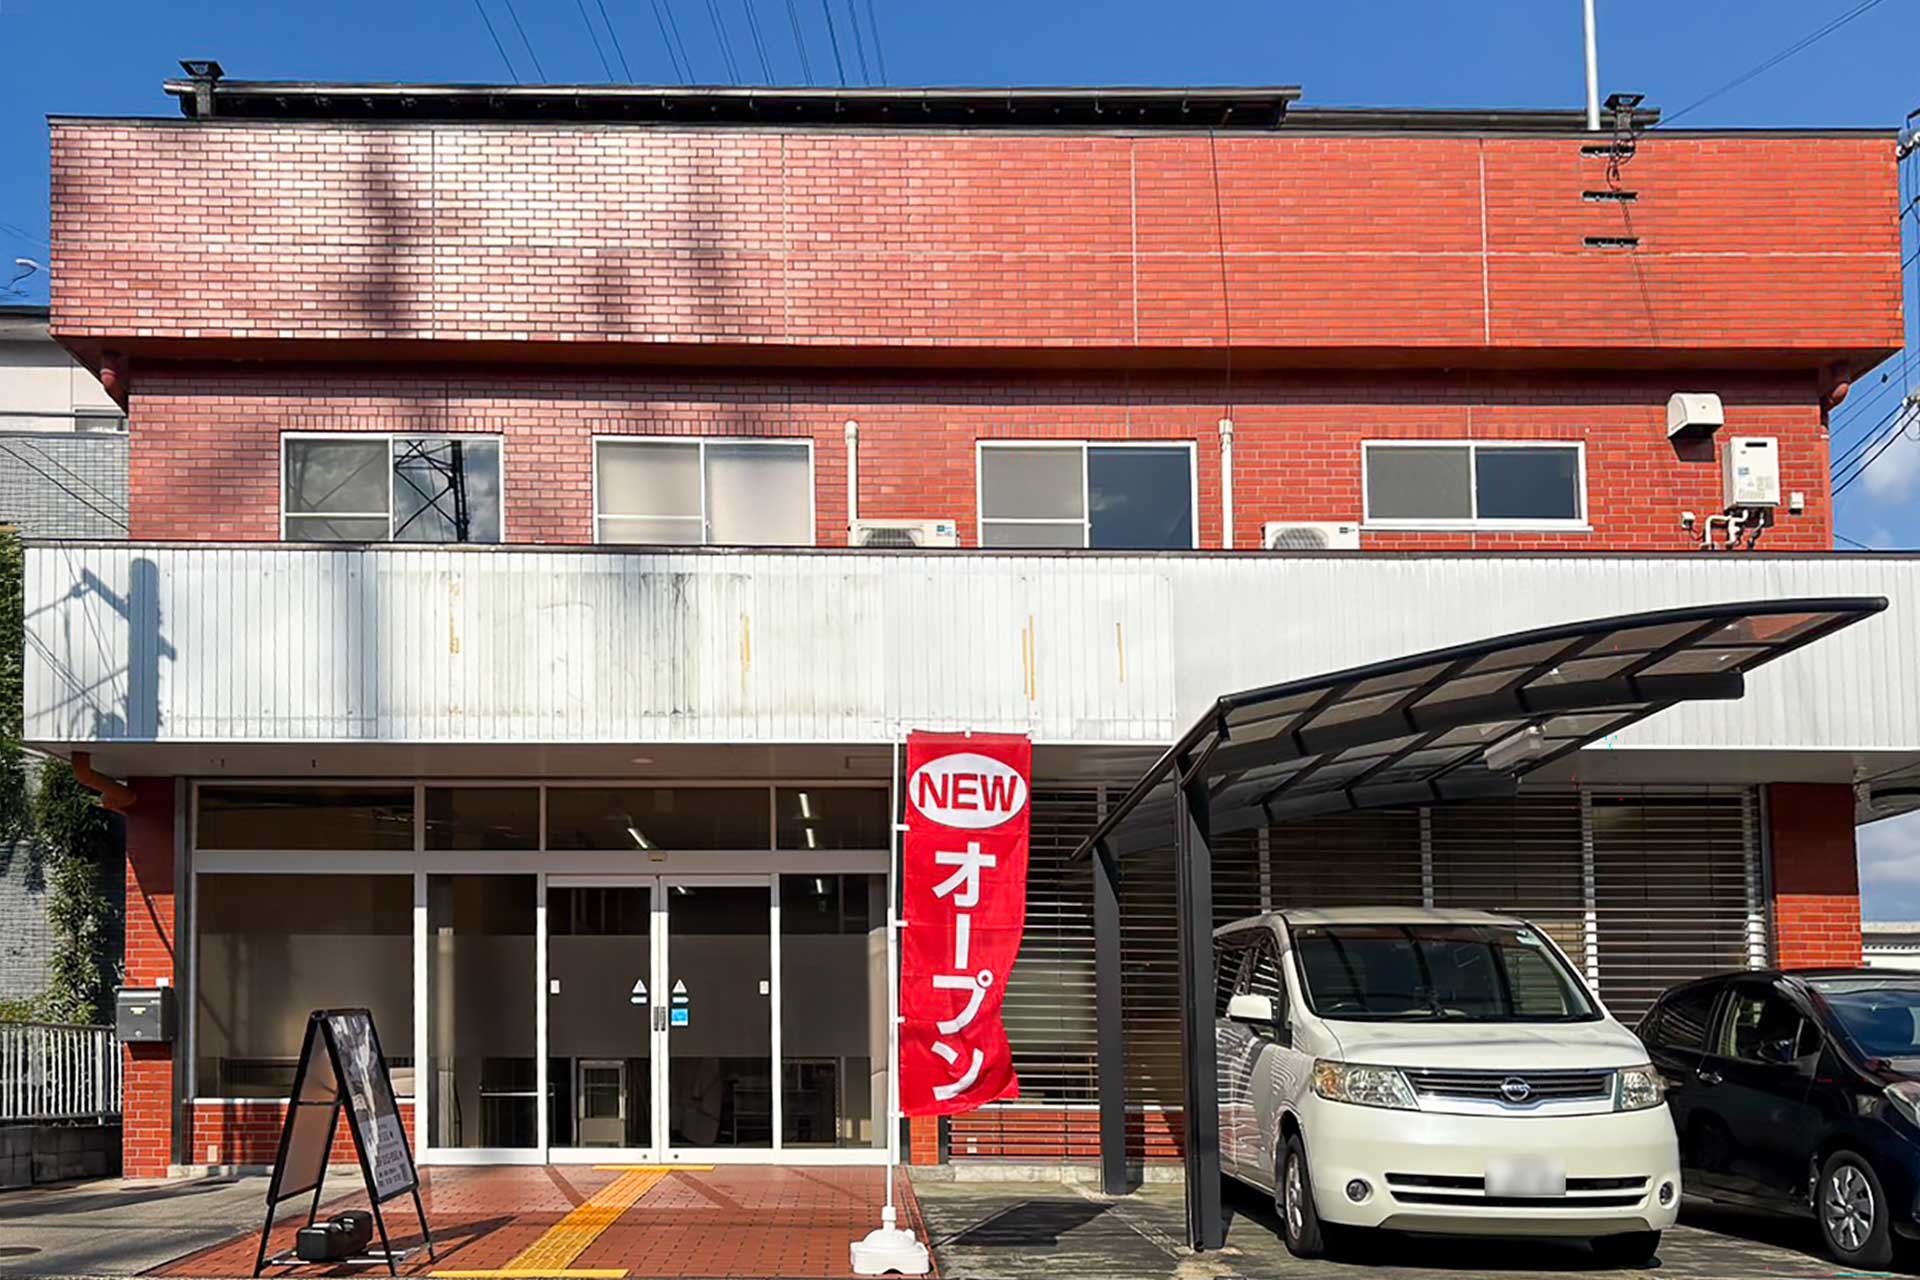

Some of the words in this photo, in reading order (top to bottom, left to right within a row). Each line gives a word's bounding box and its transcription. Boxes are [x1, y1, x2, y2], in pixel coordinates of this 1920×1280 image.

[918, 772, 1017, 812] NEW
[932, 841, 996, 1101] オープン
